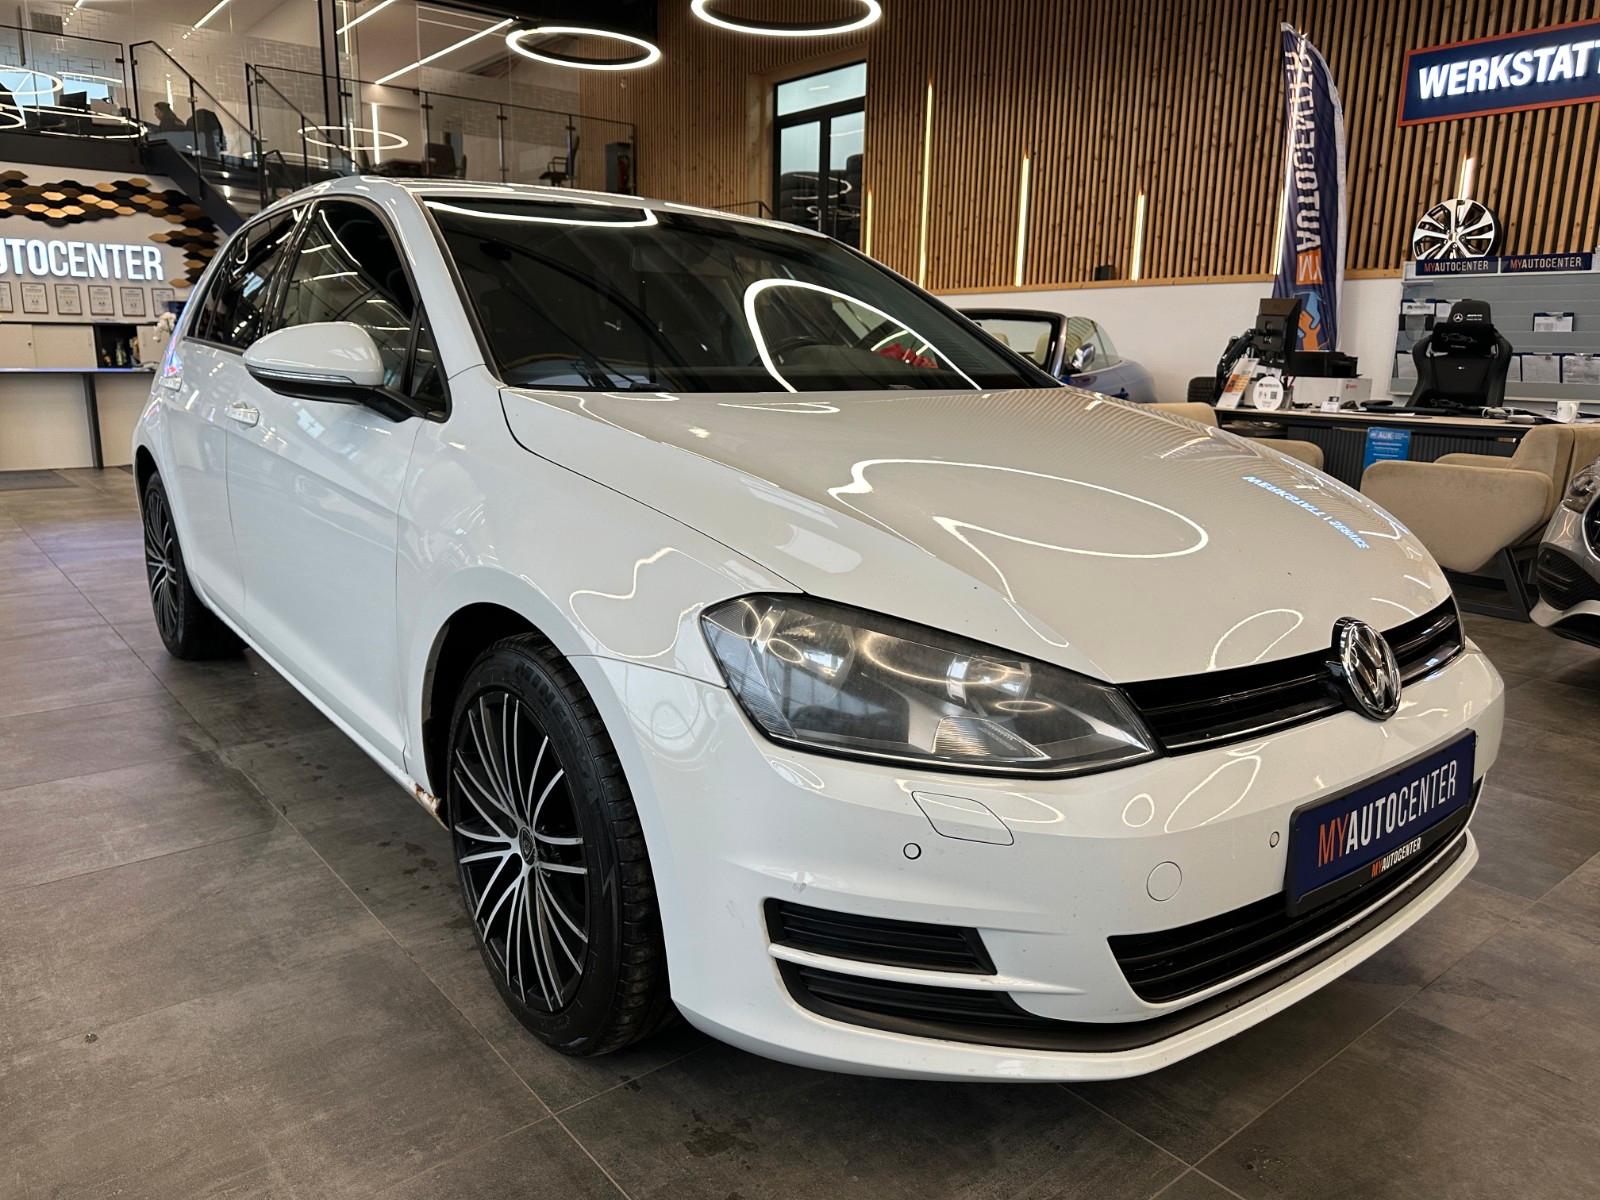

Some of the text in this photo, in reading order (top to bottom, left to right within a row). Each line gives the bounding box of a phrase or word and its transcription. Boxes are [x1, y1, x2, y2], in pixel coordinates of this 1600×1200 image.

[1423, 260, 1489, 272] MYAUTOCENTER
[1510, 256, 1582, 270] MYAUTOCENTER
[1317, 759, 1458, 868] MYAUTOCENTER
[1371, 836, 1422, 878] MYAUTOCENTER
